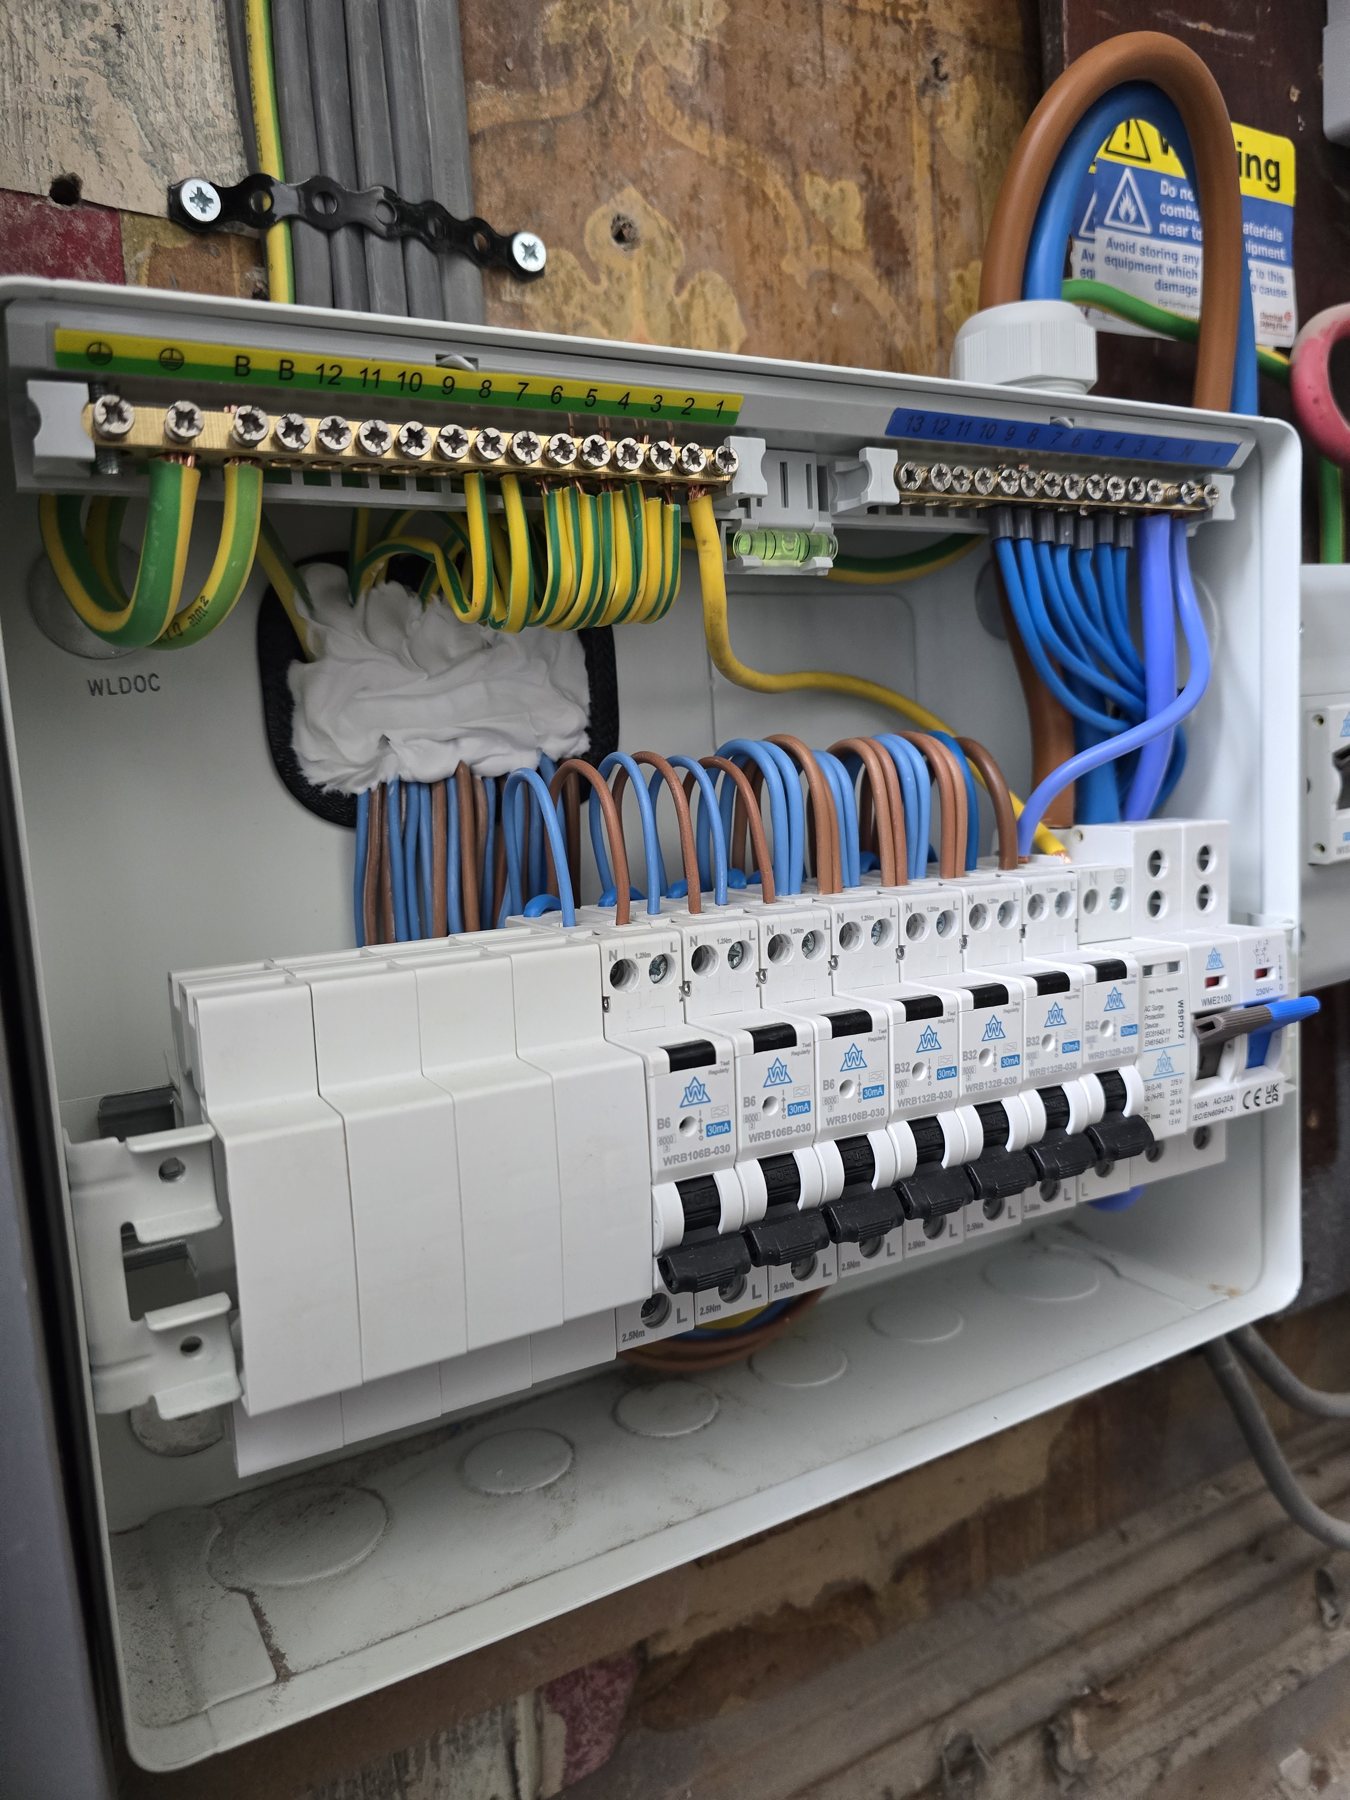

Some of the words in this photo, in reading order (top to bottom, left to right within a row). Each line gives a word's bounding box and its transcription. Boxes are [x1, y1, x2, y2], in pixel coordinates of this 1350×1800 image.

[1160, 179, 1177, 198] Do
[1180, 188, 1195, 202] no
[1159, 222, 1189, 238] near
[1242, 221, 1283, 243] aterials
[1106, 237, 1136, 254] Avoid
[1140, 245, 1179, 263] storing
[1183, 254, 1199, 267] any
[1268, 270, 1285, 284] this
[1104, 255, 1164, 275] equipment
[1166, 266, 1198, 280] which
[1259, 286, 1288, 298] cause
[1155, 279, 1198, 298] damage
[234, 355, 251, 377] B
[278, 359, 295, 381] B
[315, 363, 343, 386] 12
[359, 367, 382, 389] 11
[397, 371, 423, 393] 10
[441, 376, 456, 395] 9
[478, 379, 493, 399] 8
[515, 382, 529, 401] 7
[550, 385, 565, 405] 6
[584, 388, 598, 408] 5
[617, 391, 631, 411] 4
[650, 394, 663, 413] 3
[680, 397, 695, 416] 2
[715, 400, 725, 418] 1
[905, 415, 924, 433] 13
[931, 418, 950, 435] 12
[956, 421, 972, 437] 11
[979, 422, 997, 439] 10
[1005, 425, 1015, 441] 9
[88, 673, 161, 697] WLDOC
[905, 903, 913, 913] N
[953, 901, 959, 910] L
[967, 895, 974, 905] N
[836, 912, 845, 924] N
[889, 907, 896, 918] L
[766, 924, 775, 936] N
[824, 920, 831, 930] L
[690, 935, 698, 947] N
[748, 930, 756, 941] L
[609, 949, 618, 962] N
[670, 941, 678, 953] L
[1201, 994, 1232, 1007] WME2100
[1026, 1036, 1040, 1047] B32
[962, 1050, 978, 1061] B32
[1001, 1056, 1019, 1067] 30mA
[895, 1062, 910, 1073] B32
[938, 1068, 956, 1079] 30mA
[823, 1079, 834, 1090] B6
[863, 1086, 884, 1098] 30mA
[965, 1076, 1017, 1093] WRB132B-030
[1266, 1083, 1279, 1094] UK
[743, 1096, 756, 1108] B6
[897, 1090, 952, 1108] WRB132B-030
[788, 1103, 810, 1115] 30mA
[826, 1107, 885, 1126] WRB106B-030
[657, 1117, 671, 1130] B6
[707, 1122, 730, 1135] 30mA
[748, 1122, 811, 1143] WRB106B-030
[662, 1144, 731, 1166] WRB106B-030
[1008, 1206, 1016, 1219] L
[949, 1224, 957, 1237] L
[887, 1243, 895, 1256] L
[774, 1281, 794, 1294] 2.5Nm
[822, 1263, 832, 1277] L
[700, 1304, 721, 1316] 2.5Nm
[752, 1285, 761, 1299] L
[622, 1330, 645, 1343] 2.5Nm
[677, 1308, 687, 1324] L
